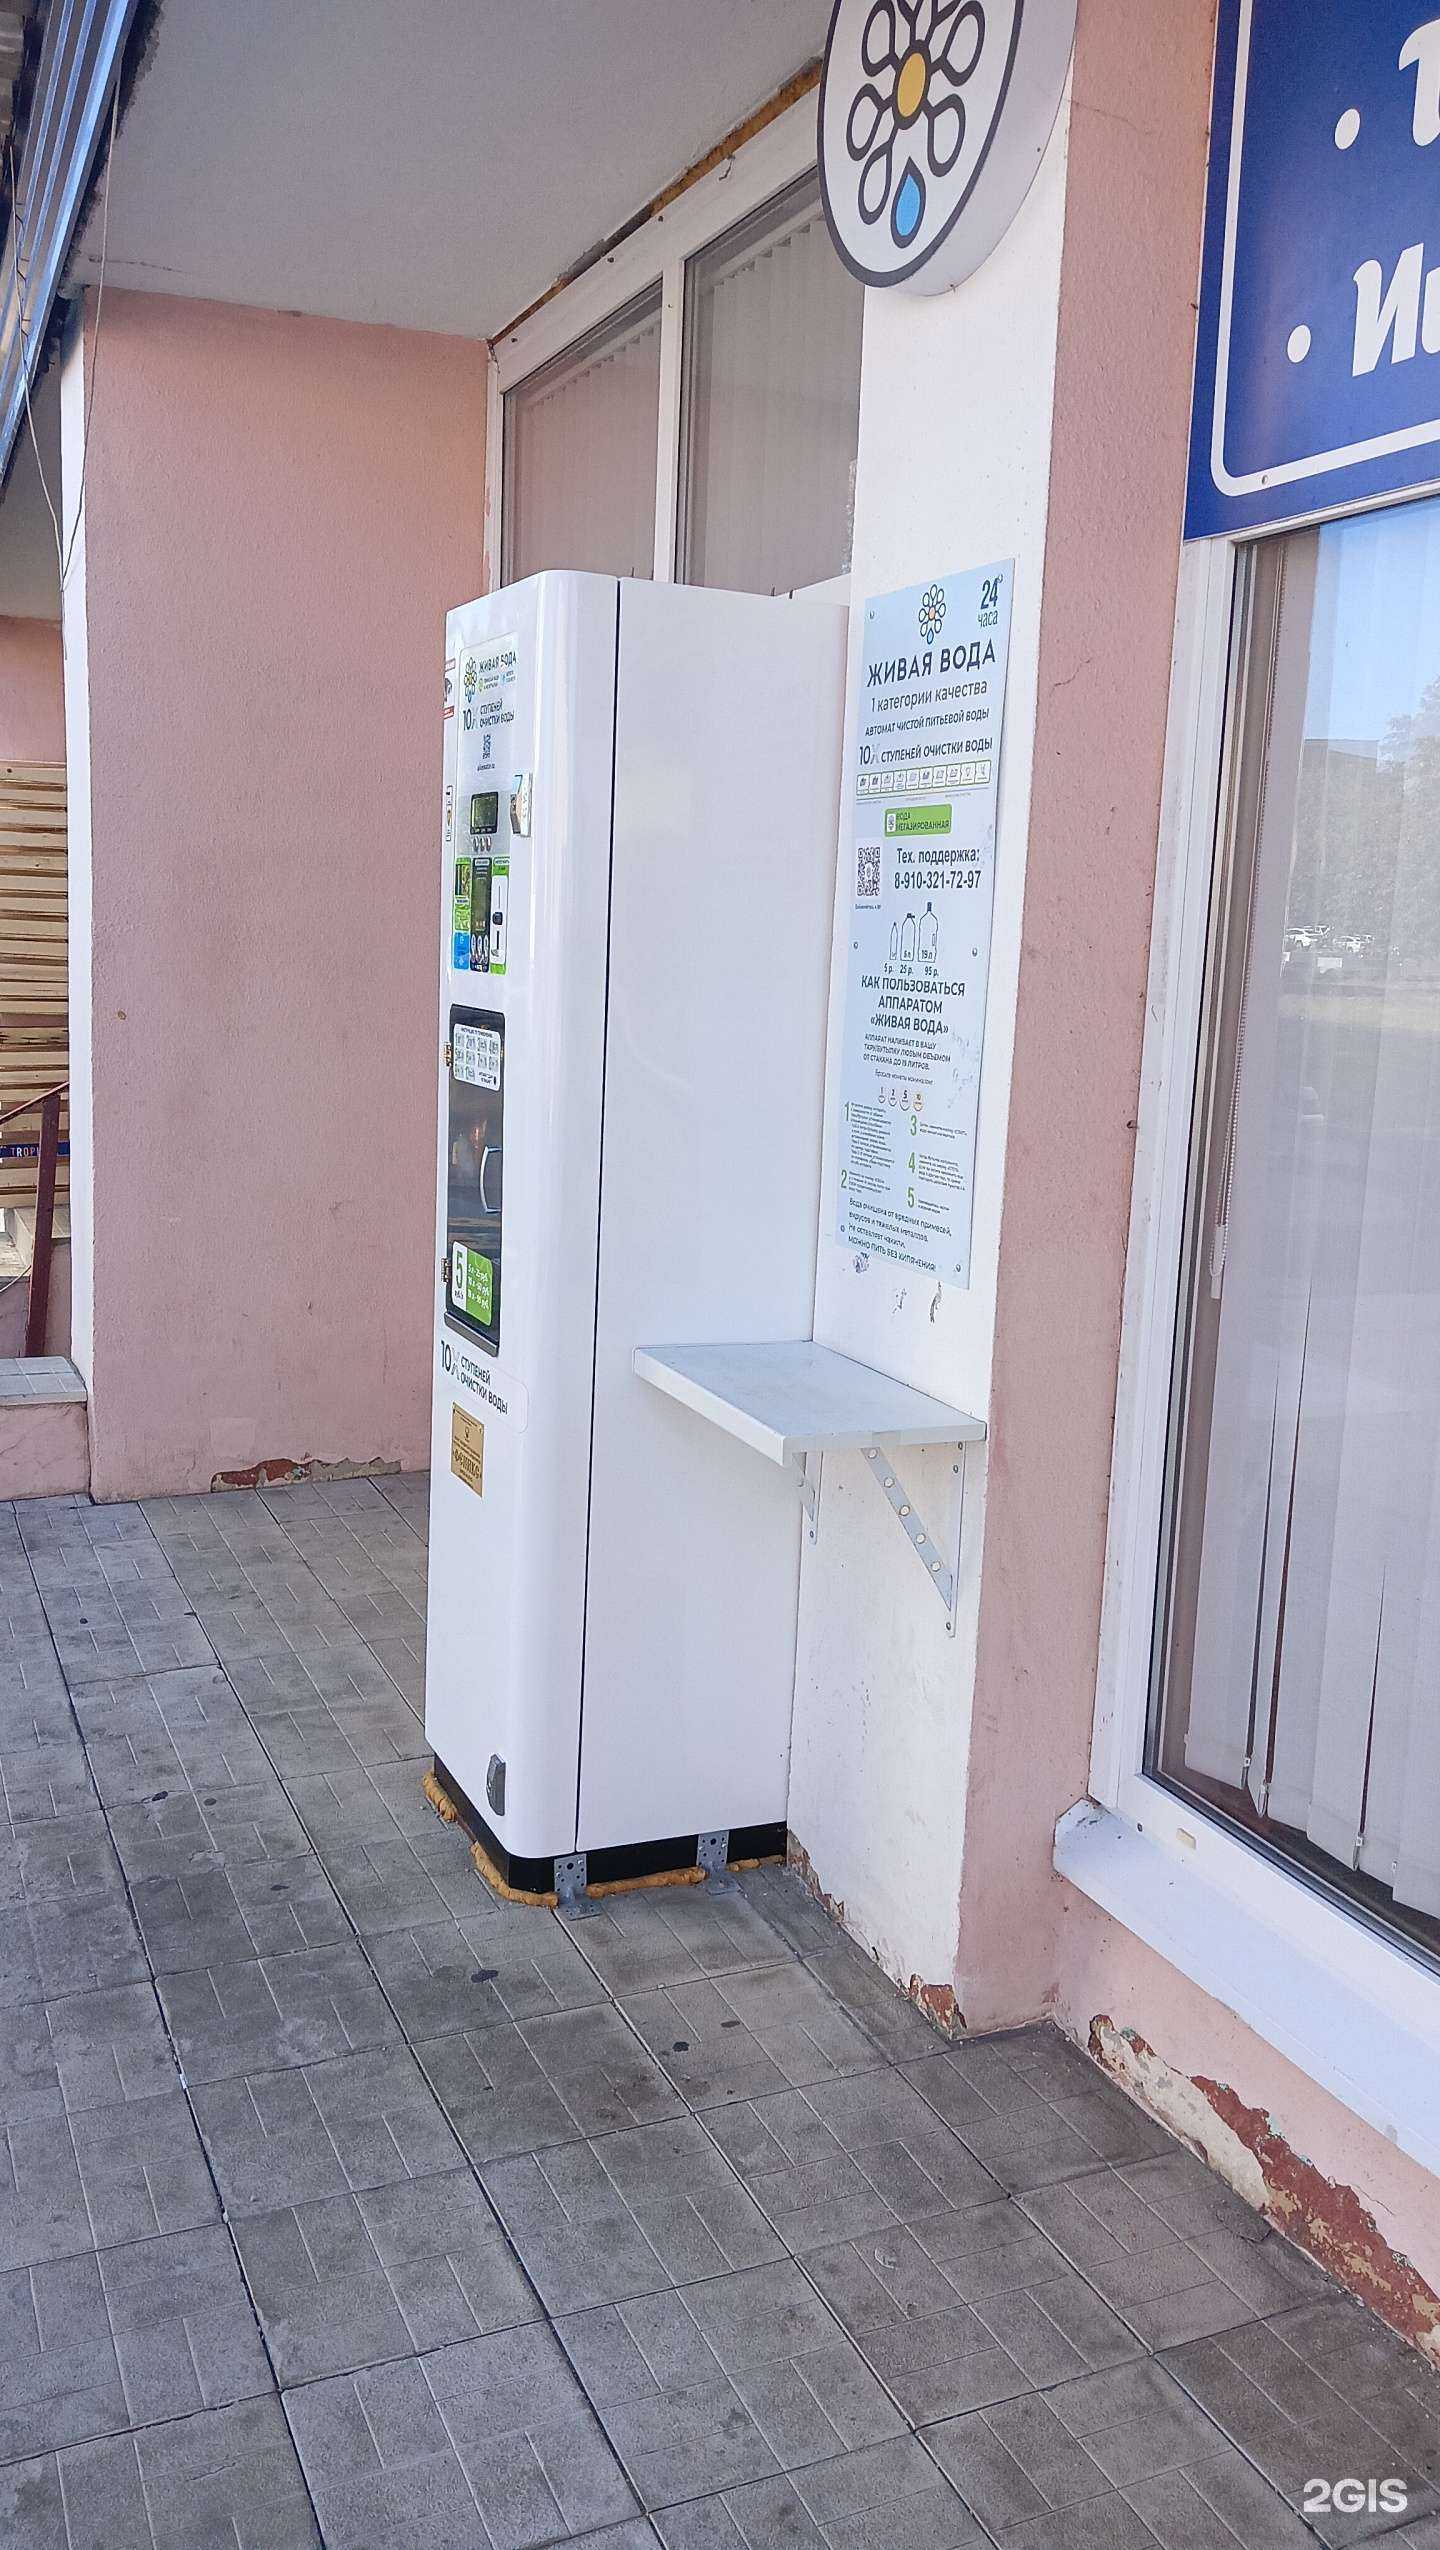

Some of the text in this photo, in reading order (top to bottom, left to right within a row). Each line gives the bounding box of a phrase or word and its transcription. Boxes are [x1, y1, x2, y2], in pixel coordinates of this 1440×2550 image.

[978, 610, 998, 628] часа
[867, 639, 995, 687] ЖИВАЯ ВОДА
[878, 691, 932, 711] категории
[935, 680, 987, 702] качества
[865, 708, 989, 736] АВТОМАТ ЧИСТОЙ ПИТЬЕВОЙ ВОДЫ
[881, 745, 921, 762] СТУПЕНЕЙ
[924, 742, 962, 757] ОЧИСТКИ
[965, 738, 992, 753] ВОДЫ
[896, 848, 980, 866] Тех. поддержка:
[894, 870, 982, 889] 8-910-321-72-97
[862, 975, 965, 996] КАК ПОЛЬЗОВАТЬСЯ
[878, 995, 943, 1014] АППАРАТОМ
[870, 1013, 949, 1036] «ЖИВАЯ ВОДА»
[845, 1101, 850, 1121] 1
[910, 1115, 917, 1136] 3
[908, 1152, 915, 1173] 4
[841, 1169, 847, 1188] 2
[907, 1187, 915, 1208] 5
[871, 1242, 886, 1256] ПИТЬ
[887, 1248, 897, 1259] БЕЗ
[456, 1250, 463, 1288] 5
[461, 1356, 490, 1385] СТУПЕНЕЙ
[461, 1372, 508, 1415] ОЧИСТКИ ВОДЫ
